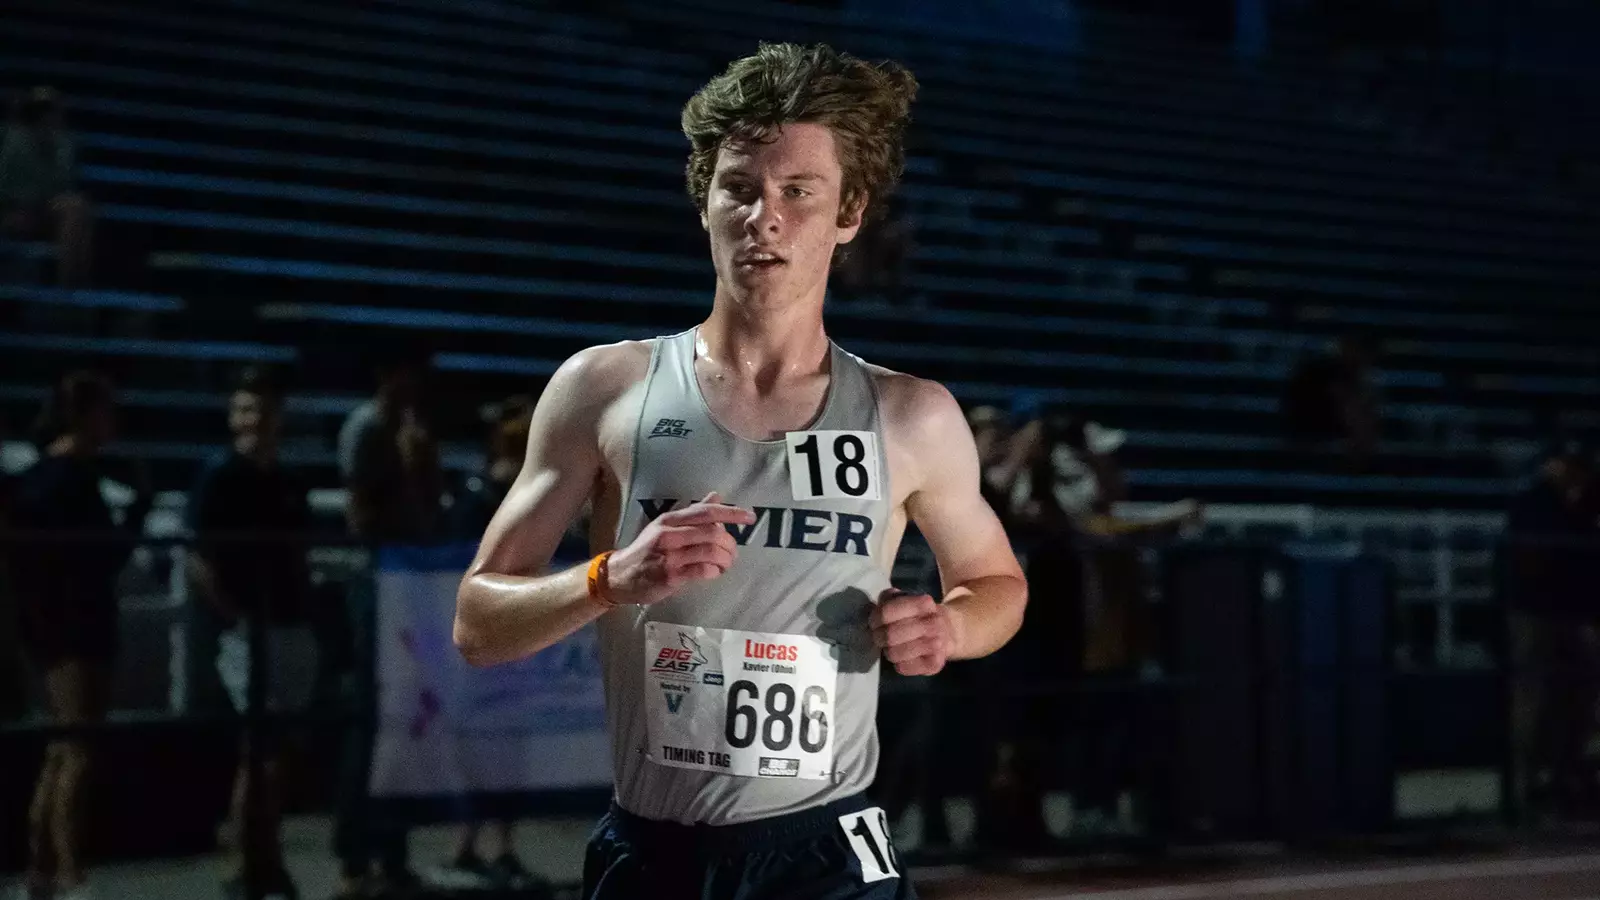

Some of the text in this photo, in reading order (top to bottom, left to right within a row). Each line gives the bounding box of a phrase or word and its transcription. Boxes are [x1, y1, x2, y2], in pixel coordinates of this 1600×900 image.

[649, 427, 693, 438] EAST
[655, 418, 686, 428] BIG
[794, 434, 869, 497] 18
[638, 499, 873, 556] VIER
[658, 647, 693, 661] BIG
[745, 640, 799, 661] Lucas
[653, 660, 702, 673] EAST
[743, 662, 770, 672] Xavier
[665, 693, 683, 713] V
[725, 679, 829, 754] 686
[662, 745, 731, 768] TIMING TAG
